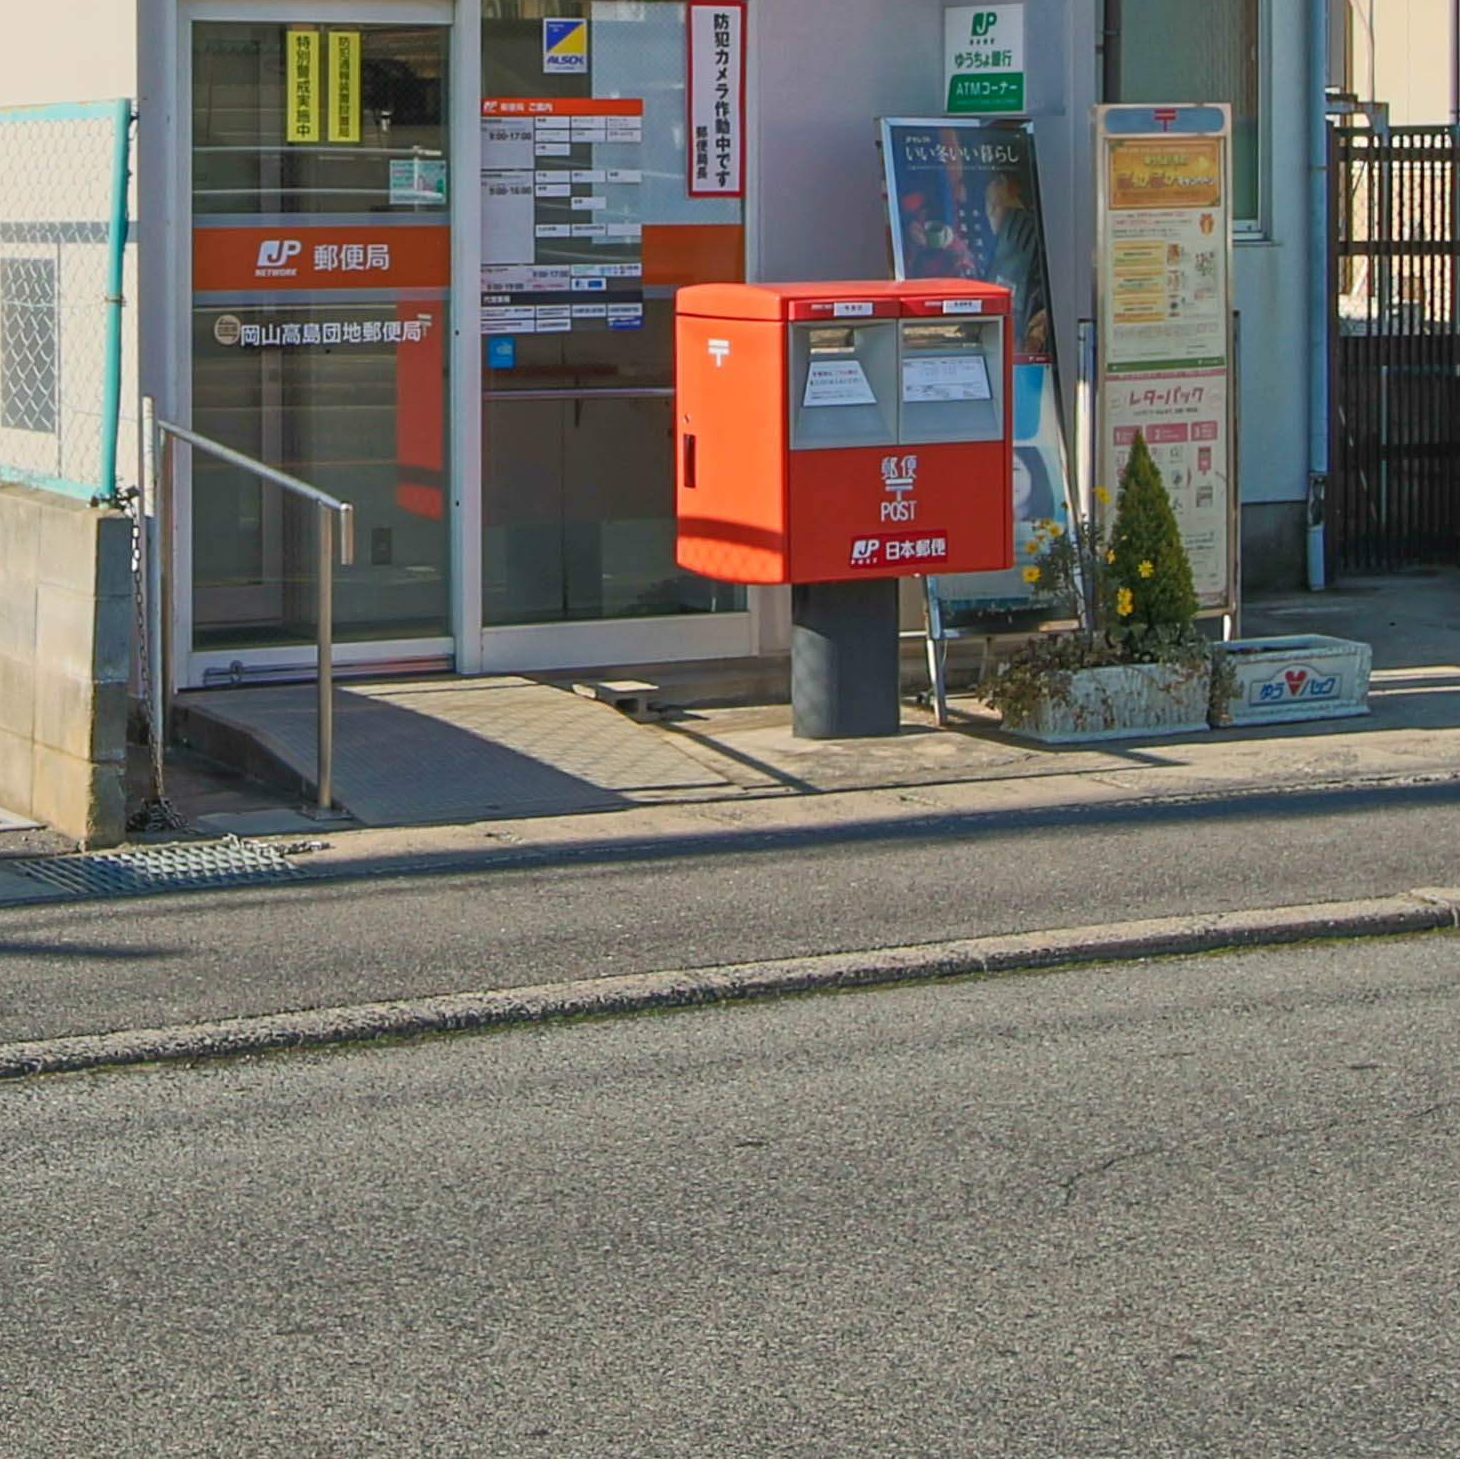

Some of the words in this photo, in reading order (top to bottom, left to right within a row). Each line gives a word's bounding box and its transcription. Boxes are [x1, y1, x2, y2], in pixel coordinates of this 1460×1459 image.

[954, 49, 1013, 69] ゆうちょ銀行
[956, 81, 1018, 96] ATMコーナー
[713, 13, 731, 188] 防犯カメラ作動中です
[695, 125, 709, 180] 郵便局長
[905, 144, 1019, 162] いい冬いい暮らし
[313, 244, 390, 272] 郵便局
[254, 268, 297, 277] NETWORK
[240, 321, 422, 347] 岡山高島団地郵便局
[1129, 386, 1204, 406] レターパック
[881, 455, 918, 480] 郵便
[881, 501, 918, 522] POST
[886, 538, 947, 560] 日本郵便
